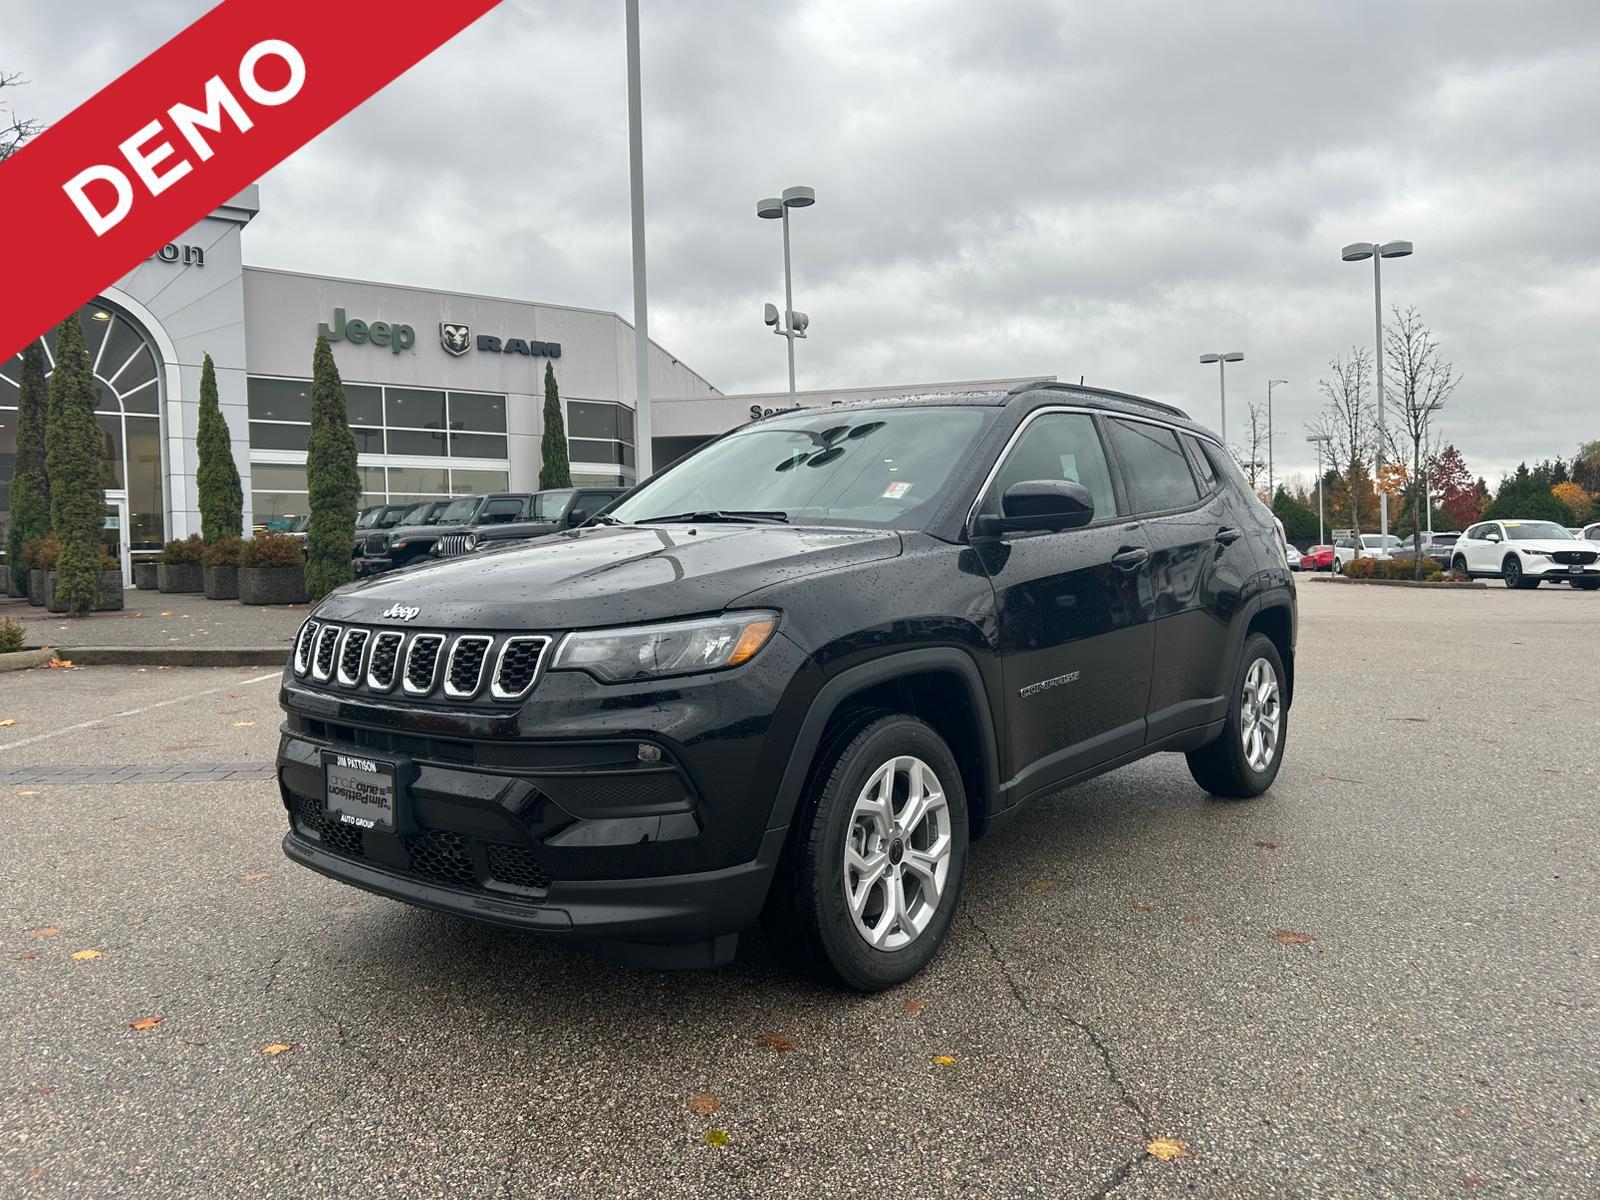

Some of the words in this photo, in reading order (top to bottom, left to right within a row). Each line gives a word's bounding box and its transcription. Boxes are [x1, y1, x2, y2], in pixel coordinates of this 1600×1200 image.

[318, 307, 416, 355] Jeep
[476, 335, 562, 359] RAM
[383, 603, 420, 622] Jeep
[347, 757, 377, 773] PATTISON
[340, 814, 354, 825] AUTO
[355, 818, 375, 829] GROUP
